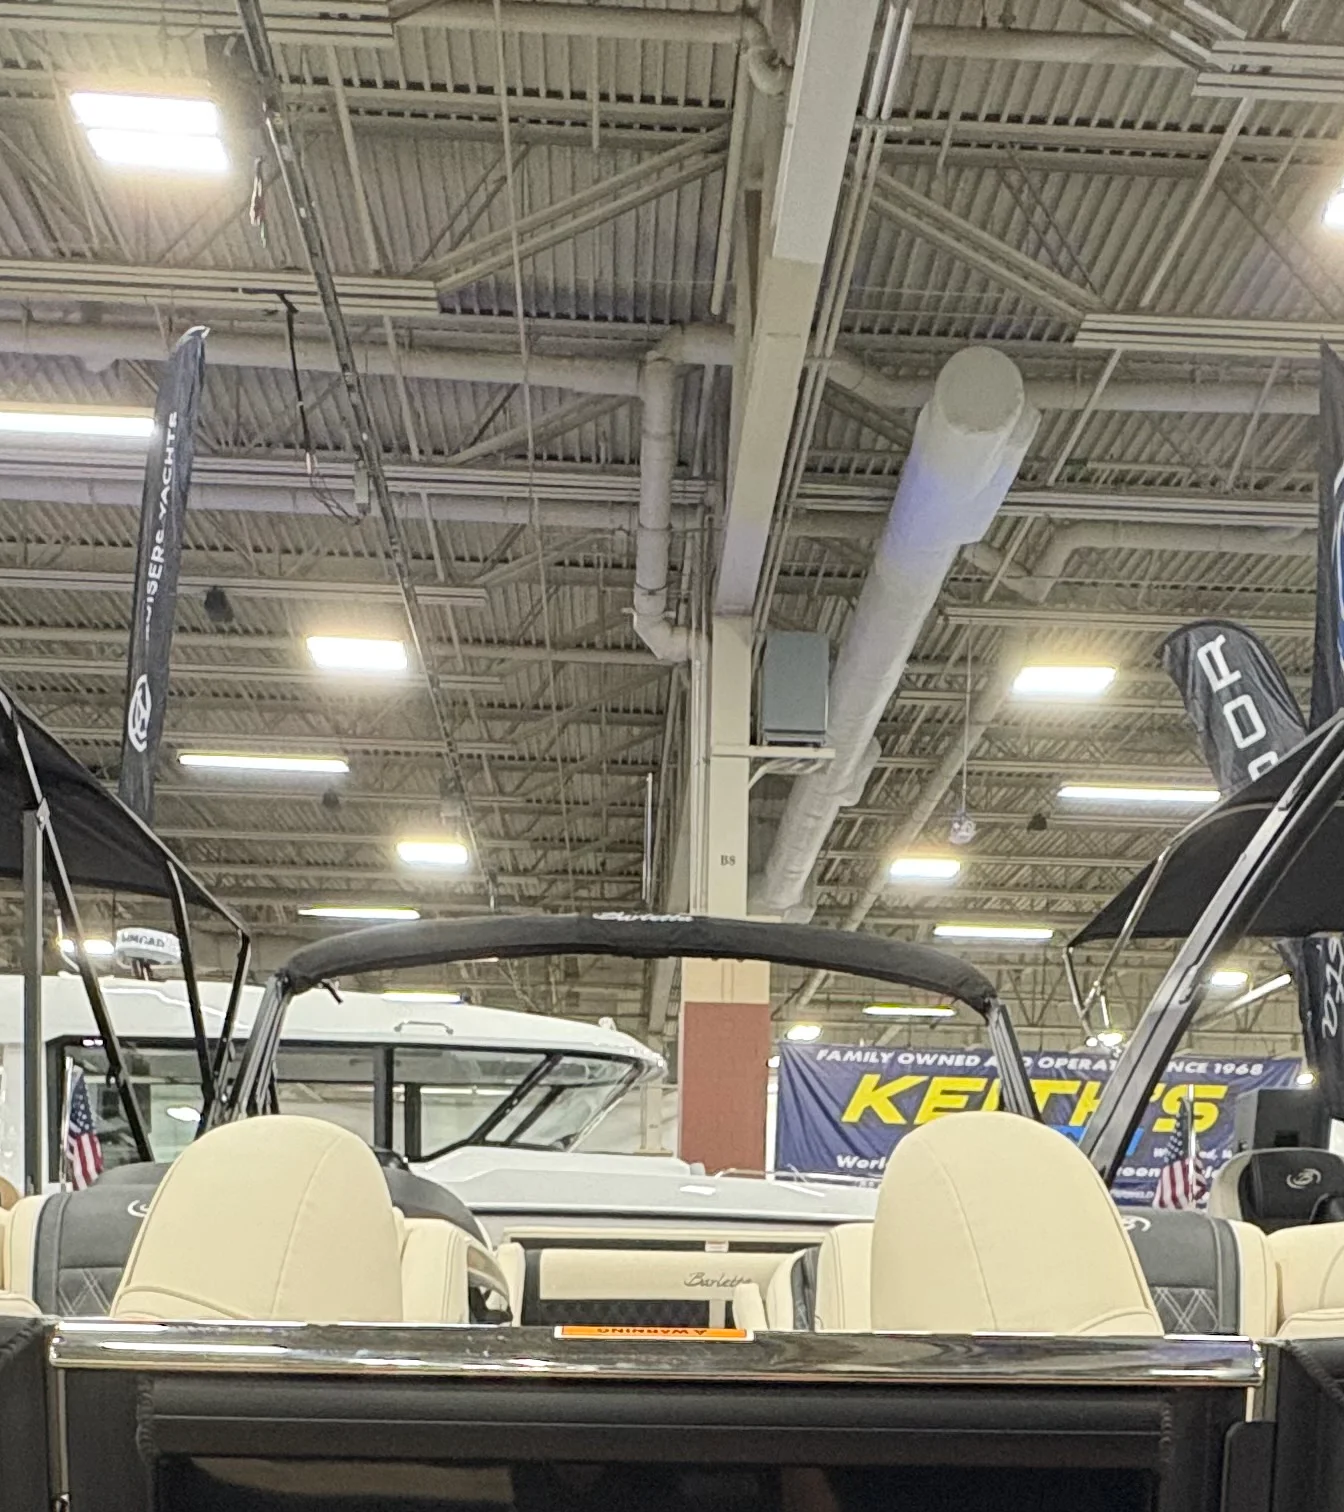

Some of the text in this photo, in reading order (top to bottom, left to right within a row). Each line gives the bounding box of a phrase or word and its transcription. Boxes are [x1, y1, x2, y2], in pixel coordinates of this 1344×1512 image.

[816, 1050, 897, 1064] FAMILY
[897, 1051, 983, 1067] OWNED
[1213, 1062, 1264, 1076] 1968
